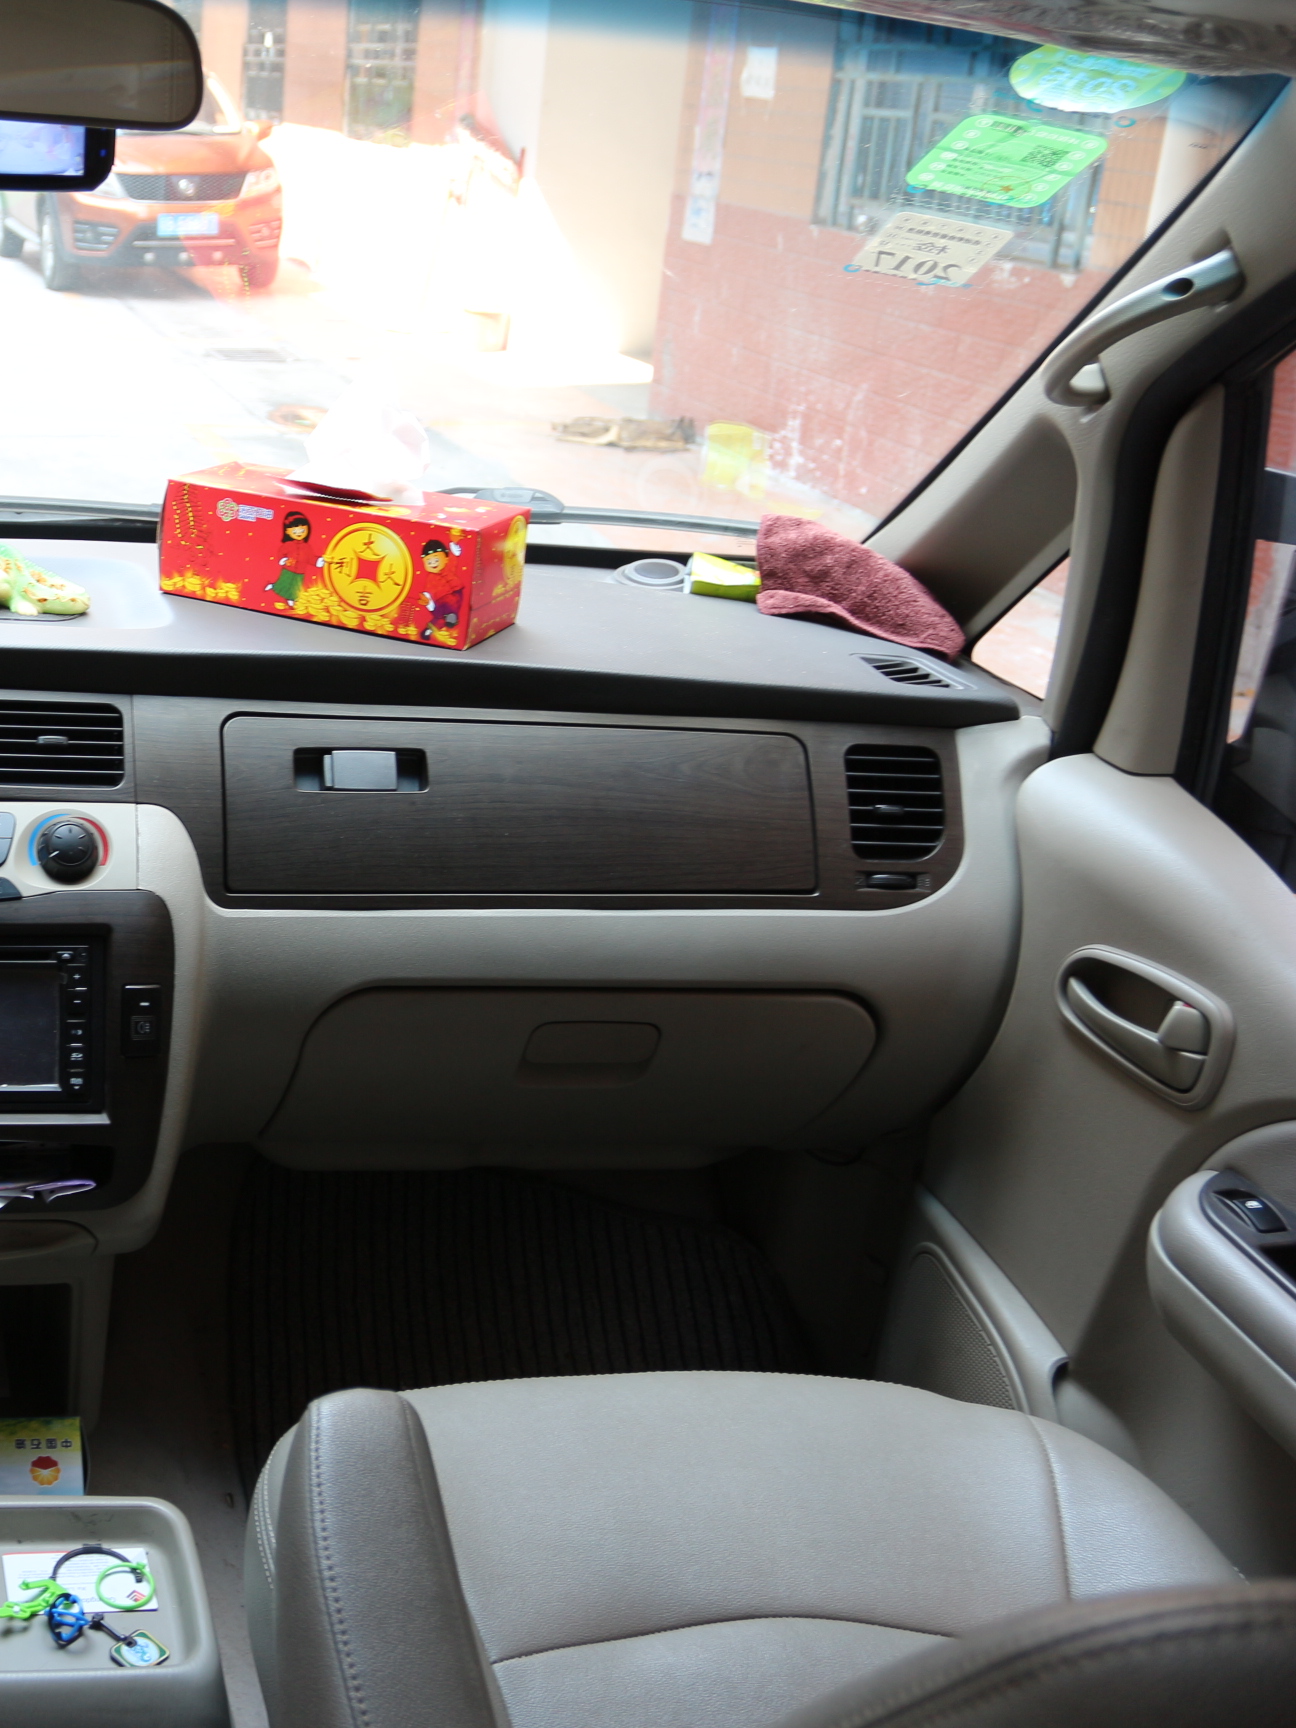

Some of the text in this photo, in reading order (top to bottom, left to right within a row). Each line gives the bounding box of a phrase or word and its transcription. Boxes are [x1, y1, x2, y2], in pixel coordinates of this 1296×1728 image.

[358, 532, 384, 557] 大
[332, 556, 353, 578] 利
[381, 561, 403, 588] 大
[355, 586, 374, 607] 吉
[14, 1437, 73, 1451] 中国石油
